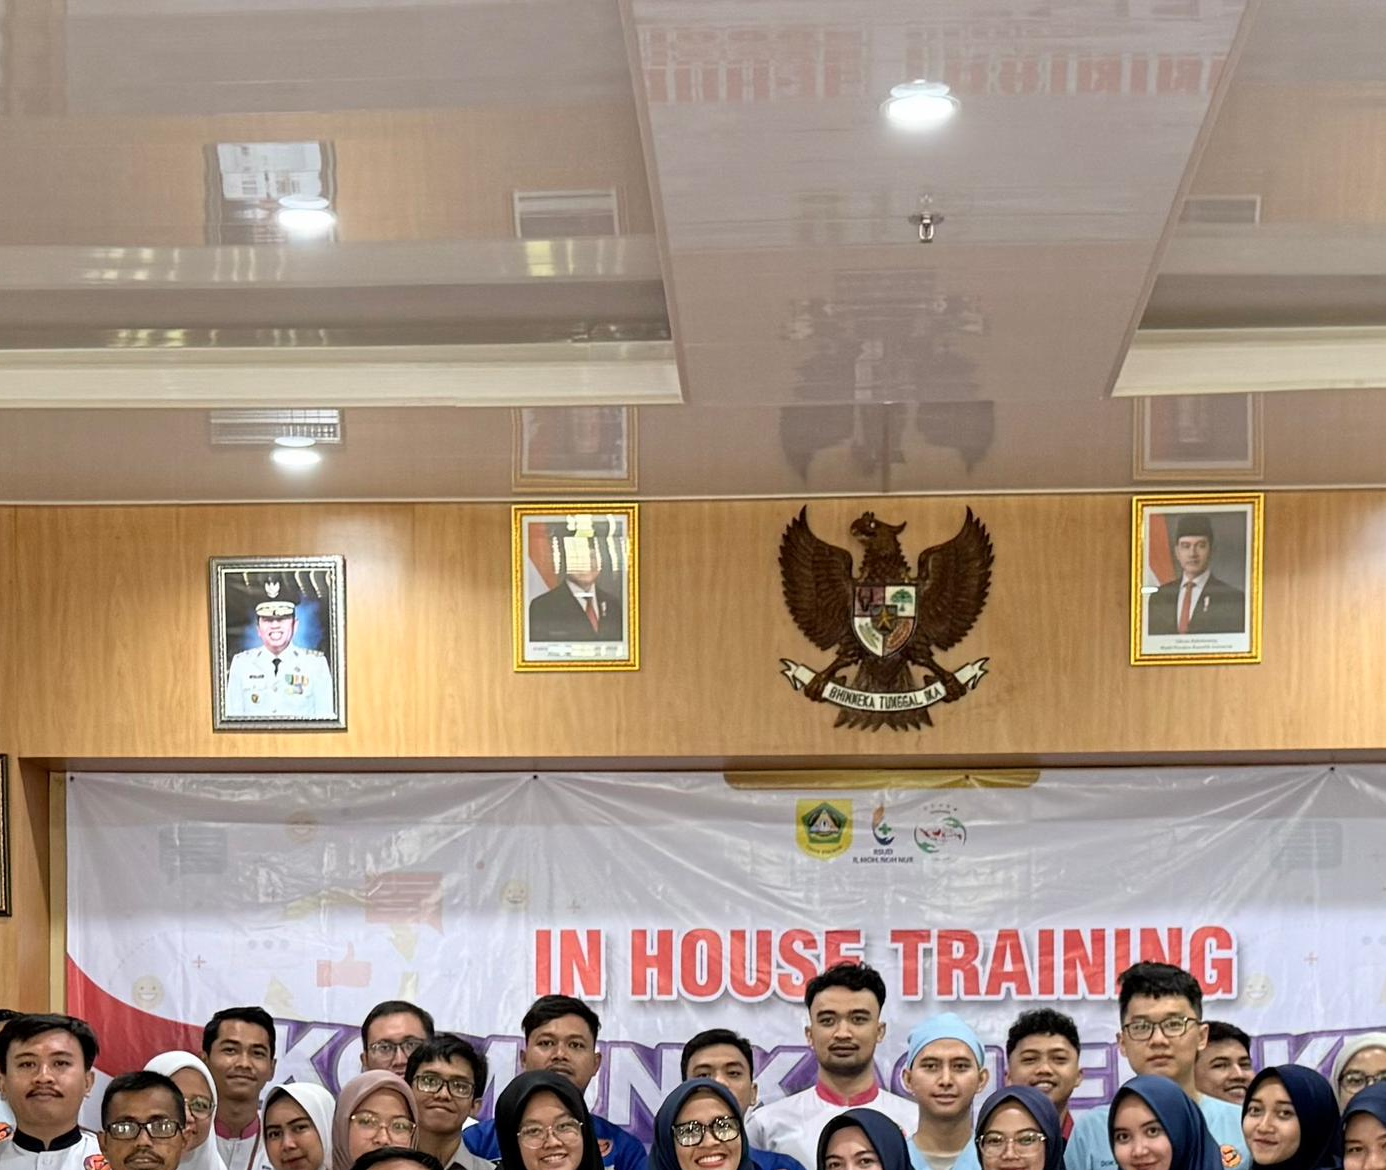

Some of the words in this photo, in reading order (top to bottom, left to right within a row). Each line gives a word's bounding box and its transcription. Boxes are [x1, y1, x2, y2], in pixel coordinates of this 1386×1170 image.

[534, 929, 603, 996] IN
[631, 928, 862, 999] HOUSE
[891, 926, 1238, 1000] TRAINING
